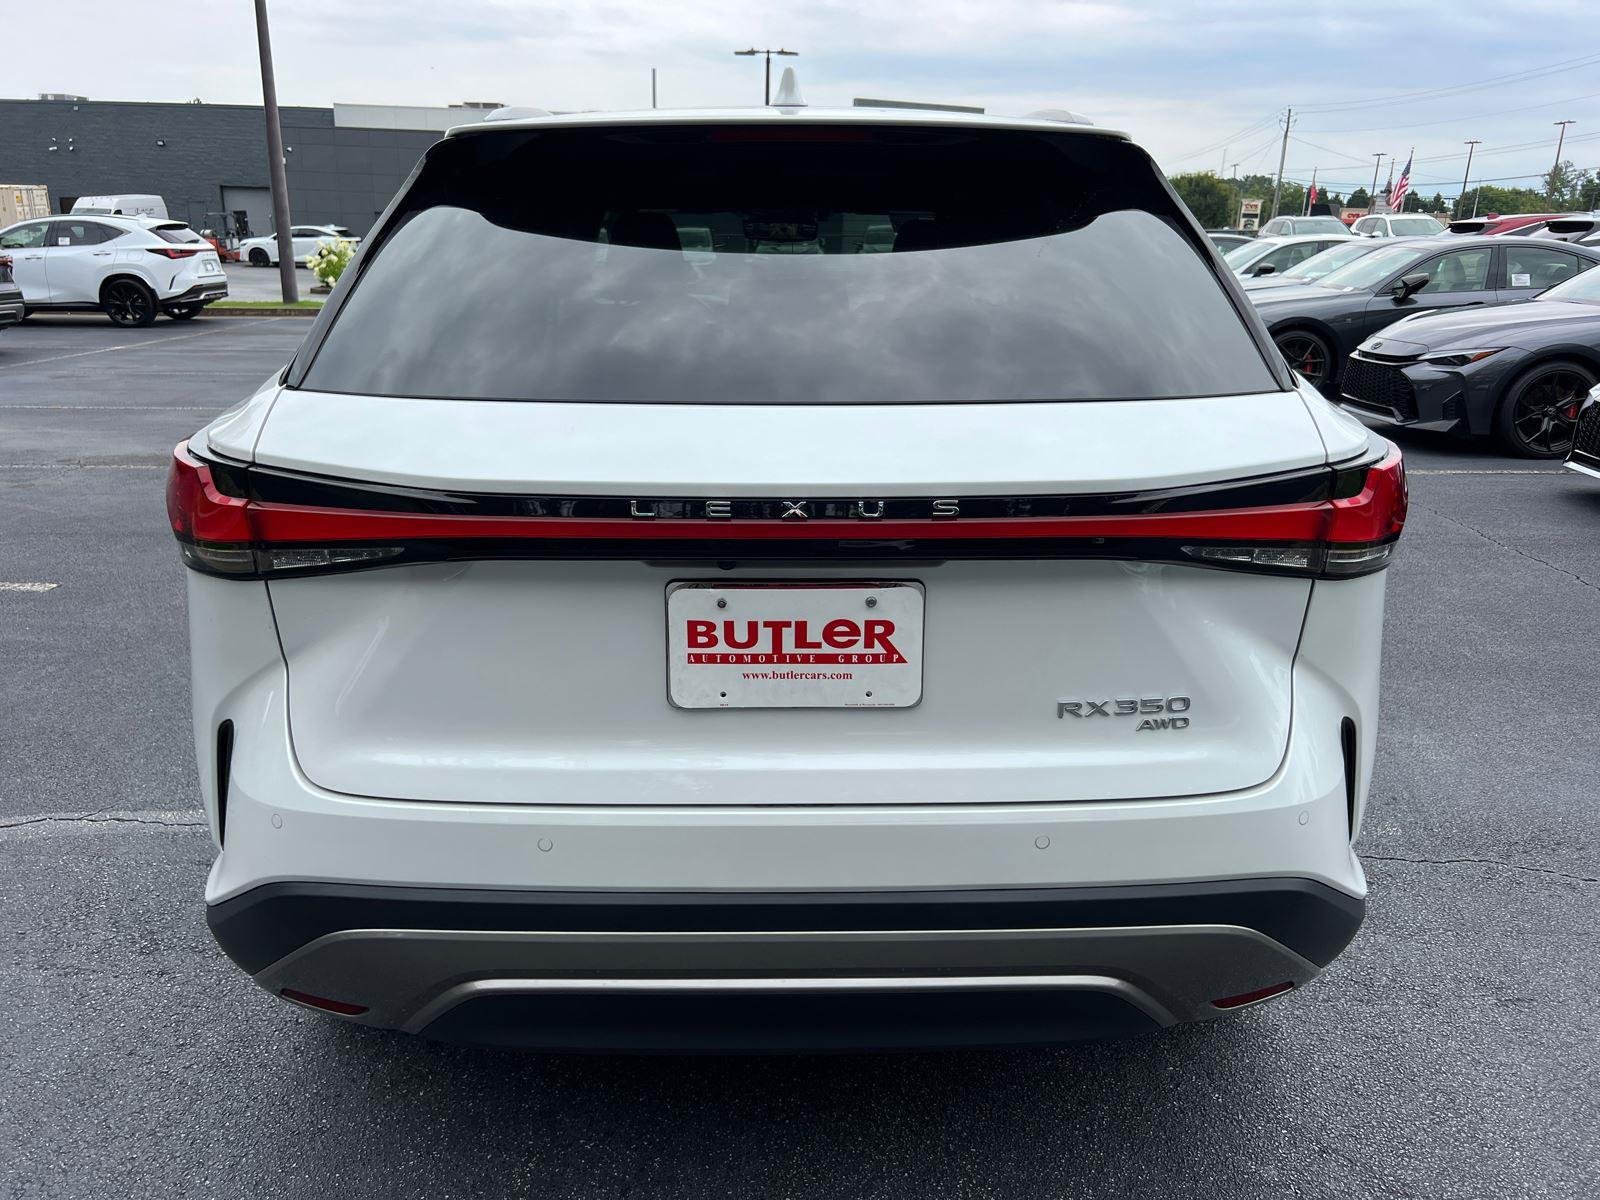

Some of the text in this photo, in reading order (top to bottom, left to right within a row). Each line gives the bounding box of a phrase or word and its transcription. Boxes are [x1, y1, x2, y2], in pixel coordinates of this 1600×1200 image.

[630, 498, 961, 519] LEXUS
[688, 654, 902, 664] AUTOMOTIVE GROUP
[742, 670, 853, 680] www.butlercars.com
[1136, 717, 1190, 731] AWD
